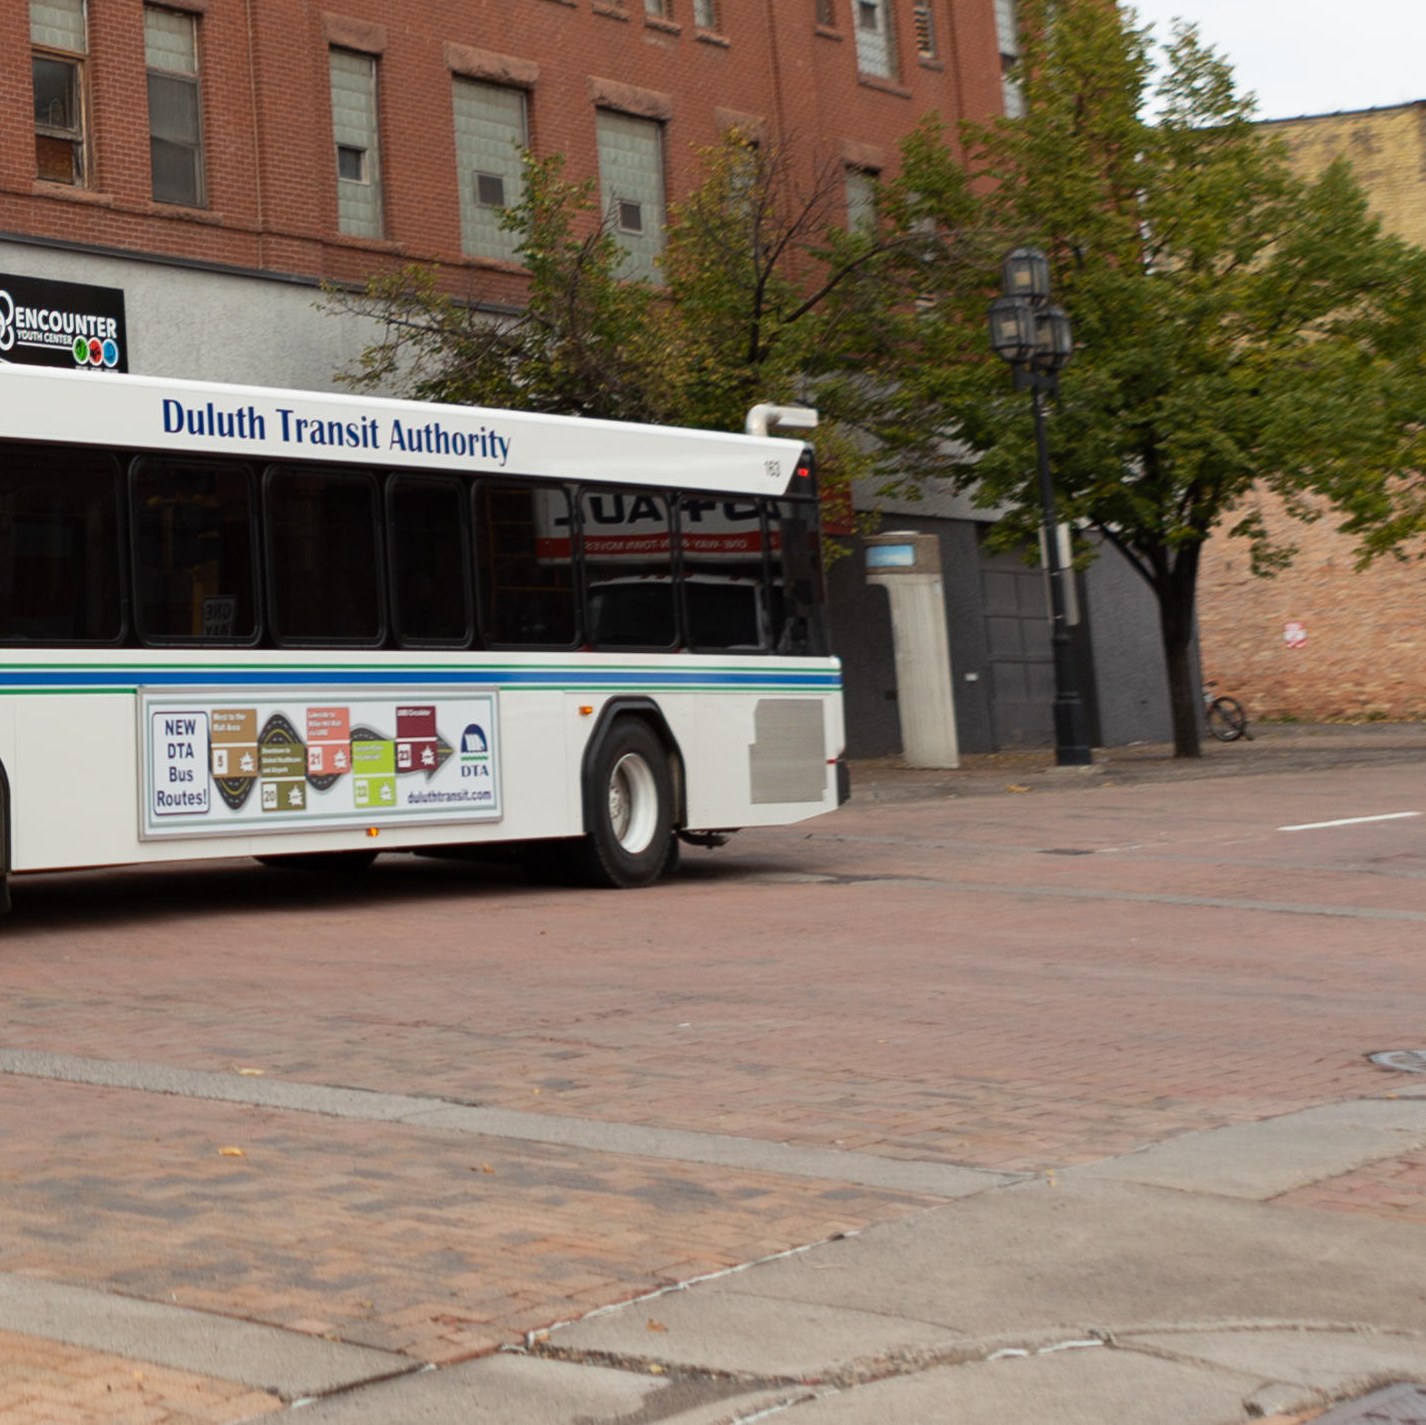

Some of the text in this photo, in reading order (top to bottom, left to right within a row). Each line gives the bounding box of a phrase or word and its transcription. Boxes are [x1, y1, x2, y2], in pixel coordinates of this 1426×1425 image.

[15, 307, 117, 338] ENCOUNTER
[17, 329, 73, 345] YOUTH CENTER
[162, 399, 511, 467] Duluth Transit Authority
[165, 719, 196, 736] NEW
[167, 743, 194, 759] DTA
[310, 753, 321, 766] 21
[169, 766, 194, 782] Bus
[460, 764, 489, 778] DTA
[157, 788, 207, 807] Routes!
[407, 788, 492, 804] duluthtransit.com
